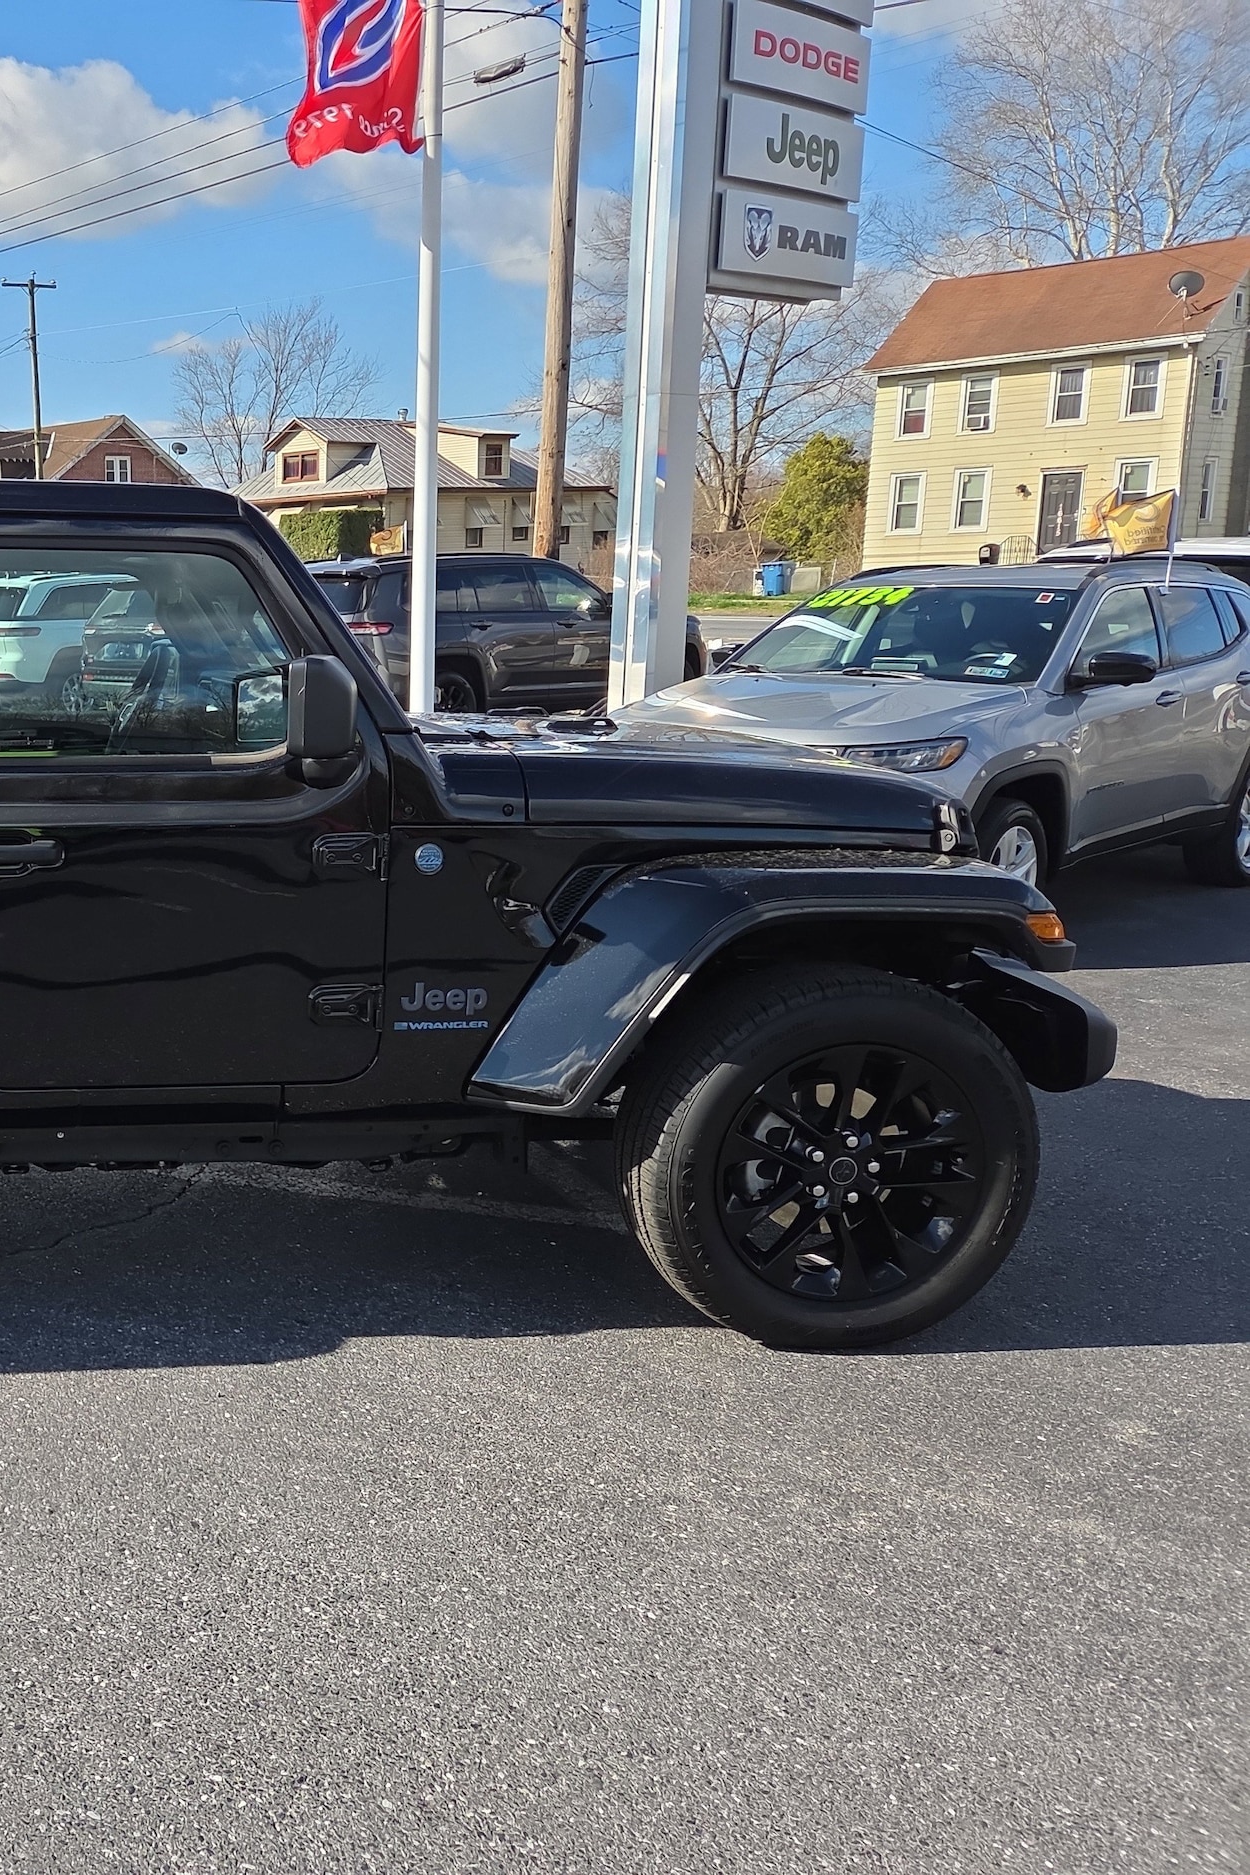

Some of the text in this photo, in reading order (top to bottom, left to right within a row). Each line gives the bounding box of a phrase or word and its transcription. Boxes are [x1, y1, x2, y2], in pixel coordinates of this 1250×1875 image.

[754, 29, 860, 84] DODGE
[766, 113, 840, 186] Jeep
[777, 224, 847, 260] RAM
[400, 982, 488, 1016] Jeep
[408, 1020, 489, 1030] WRANGLER
